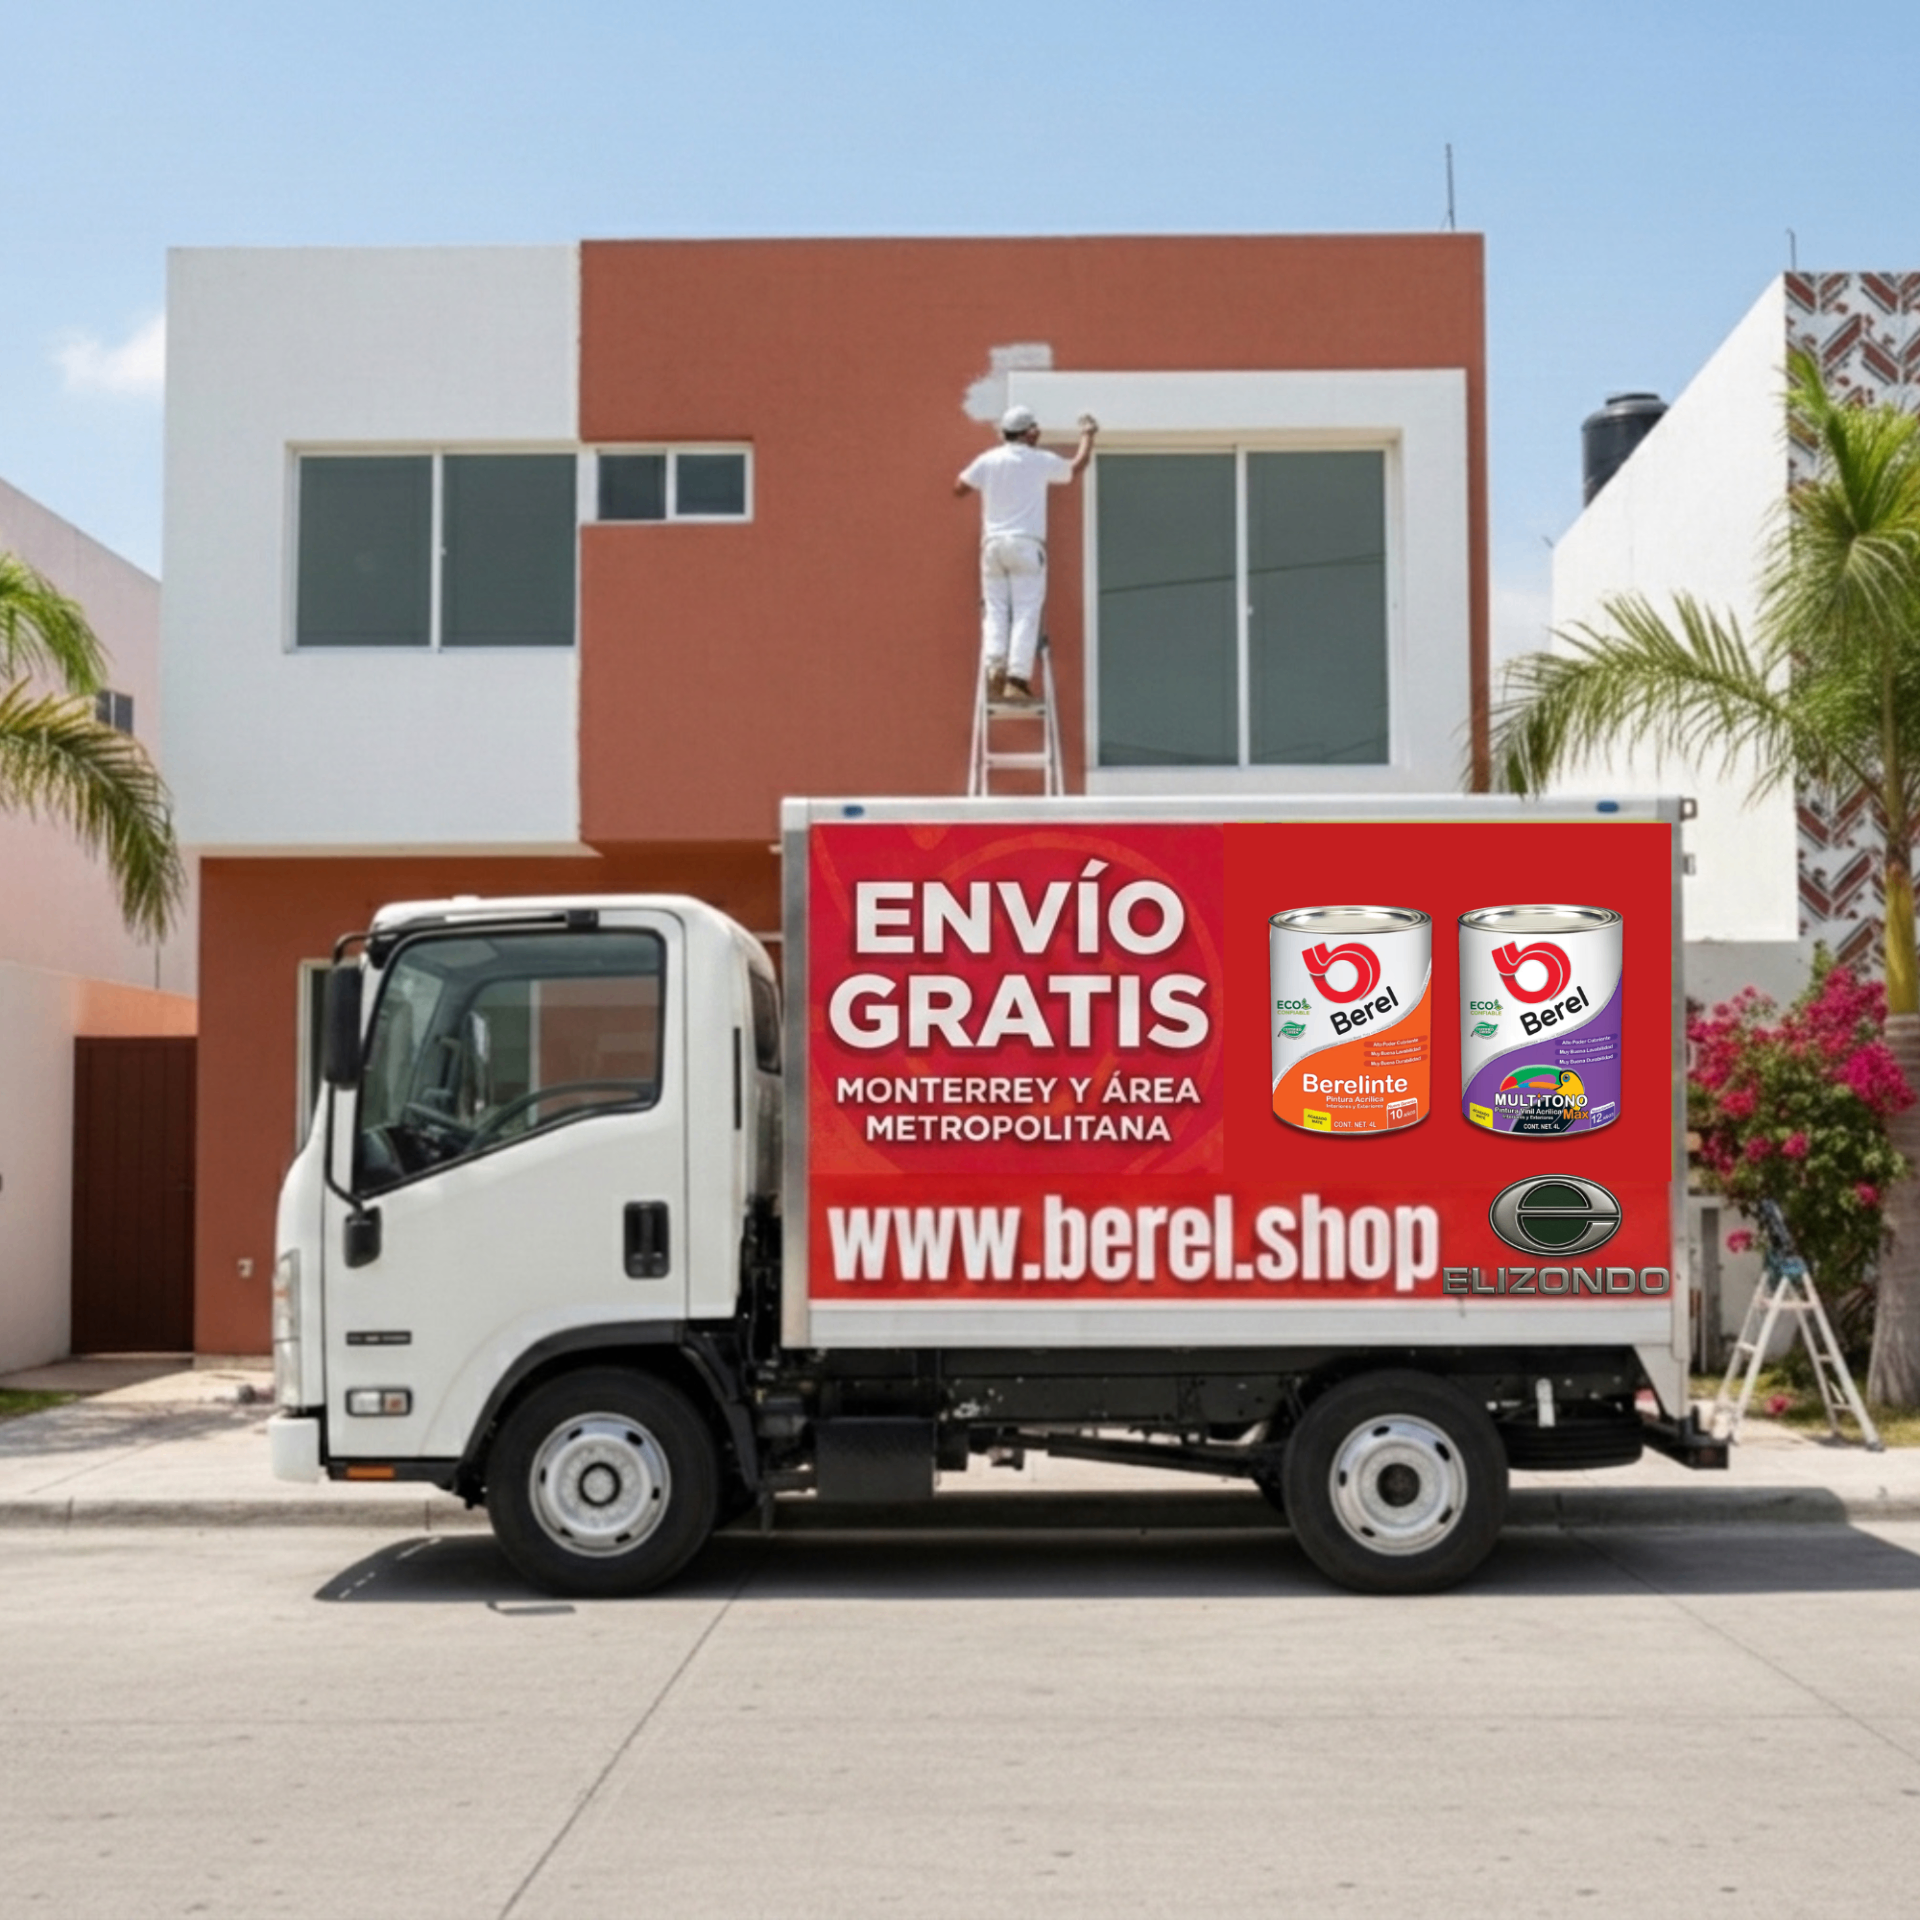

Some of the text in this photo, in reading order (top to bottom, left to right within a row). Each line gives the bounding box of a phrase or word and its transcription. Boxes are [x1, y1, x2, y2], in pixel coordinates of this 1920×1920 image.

[857, 859, 1184, 954] ENVÍO
[830, 974, 1208, 1048] GRATIS
[1277, 1000, 1302, 1010] ECO
[1329, 986, 1399, 1036] Berel
[1470, 1001, 1494, 1010] ECO
[1519, 986, 1590, 1036] Berel
[838, 1070, 1199, 1102] MONTERREY Y ÁREA
[1303, 1073, 1408, 1094] Berelinte
[1326, 1095, 1353, 1103] Pintura
[1390, 1108, 1403, 1120] 10
[1494, 1107, 1520, 1115] Pintura
[1563, 1108, 1589, 1120] Max
[1591, 1112, 1602, 1124] 12
[868, 1115, 1170, 1140] METROPOLITANA
[828, 1194, 1438, 1291] www.berel.shop
[1442, 1267, 1670, 1295] ELIZONDO
